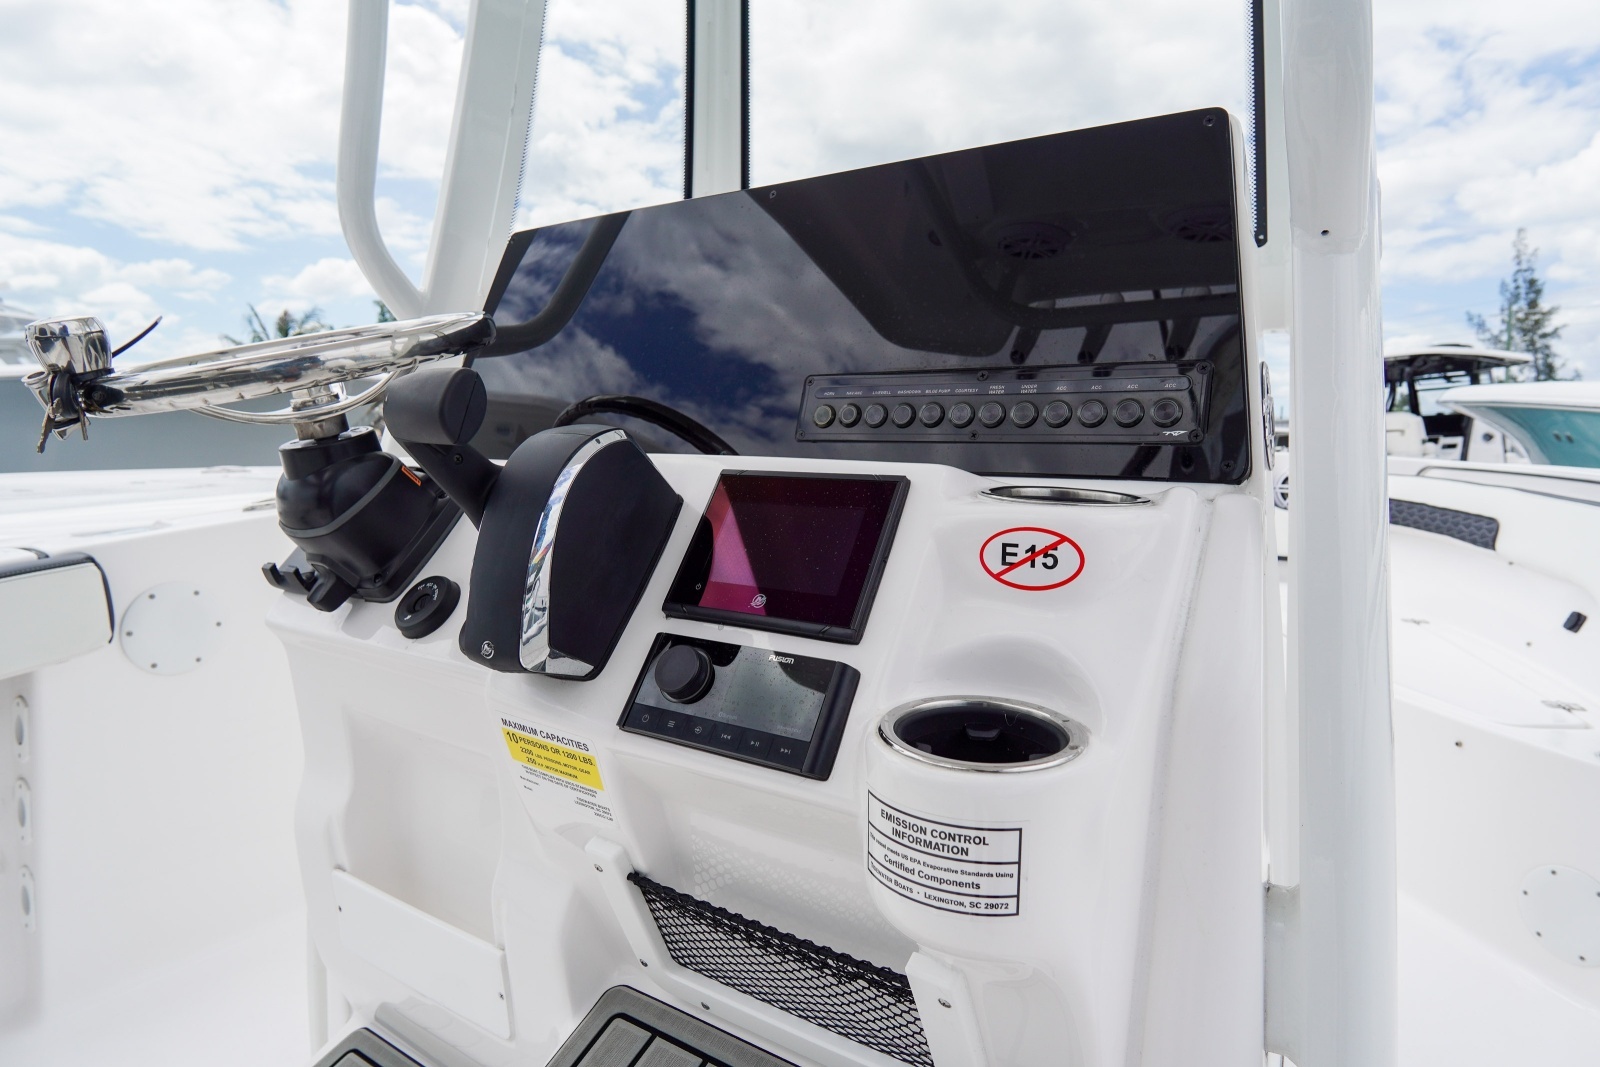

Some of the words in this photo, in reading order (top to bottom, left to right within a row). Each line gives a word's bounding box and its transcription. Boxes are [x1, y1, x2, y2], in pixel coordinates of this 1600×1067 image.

[1001, 543, 1059, 570] E15
[768, 654, 795, 665] FUSION
[501, 718, 539, 737] MAXIMUM
[540, 730, 590, 752] CAPACITIES
[506, 731, 519, 744] 10
[519, 736, 550, 752] PERSONS
[550, 746, 561, 755] OR
[880, 808, 927, 836] EMISSION
[930, 829, 990, 846] CONTROL
[892, 826, 970, 857] INFORMATION
[884, 854, 916, 876] Certified
[918, 870, 981, 890] Components
[887, 845, 901, 857] meets
[910, 856, 922, 866] EPA
[923, 861, 959, 875] Evaporative
[960, 869, 994, 878] Standards
[894, 878, 914, 894] BOATS
[924, 892, 967, 909] LEXINGTON,
[969, 901, 982, 910] SC
[984, 902, 1009, 910] 29072
